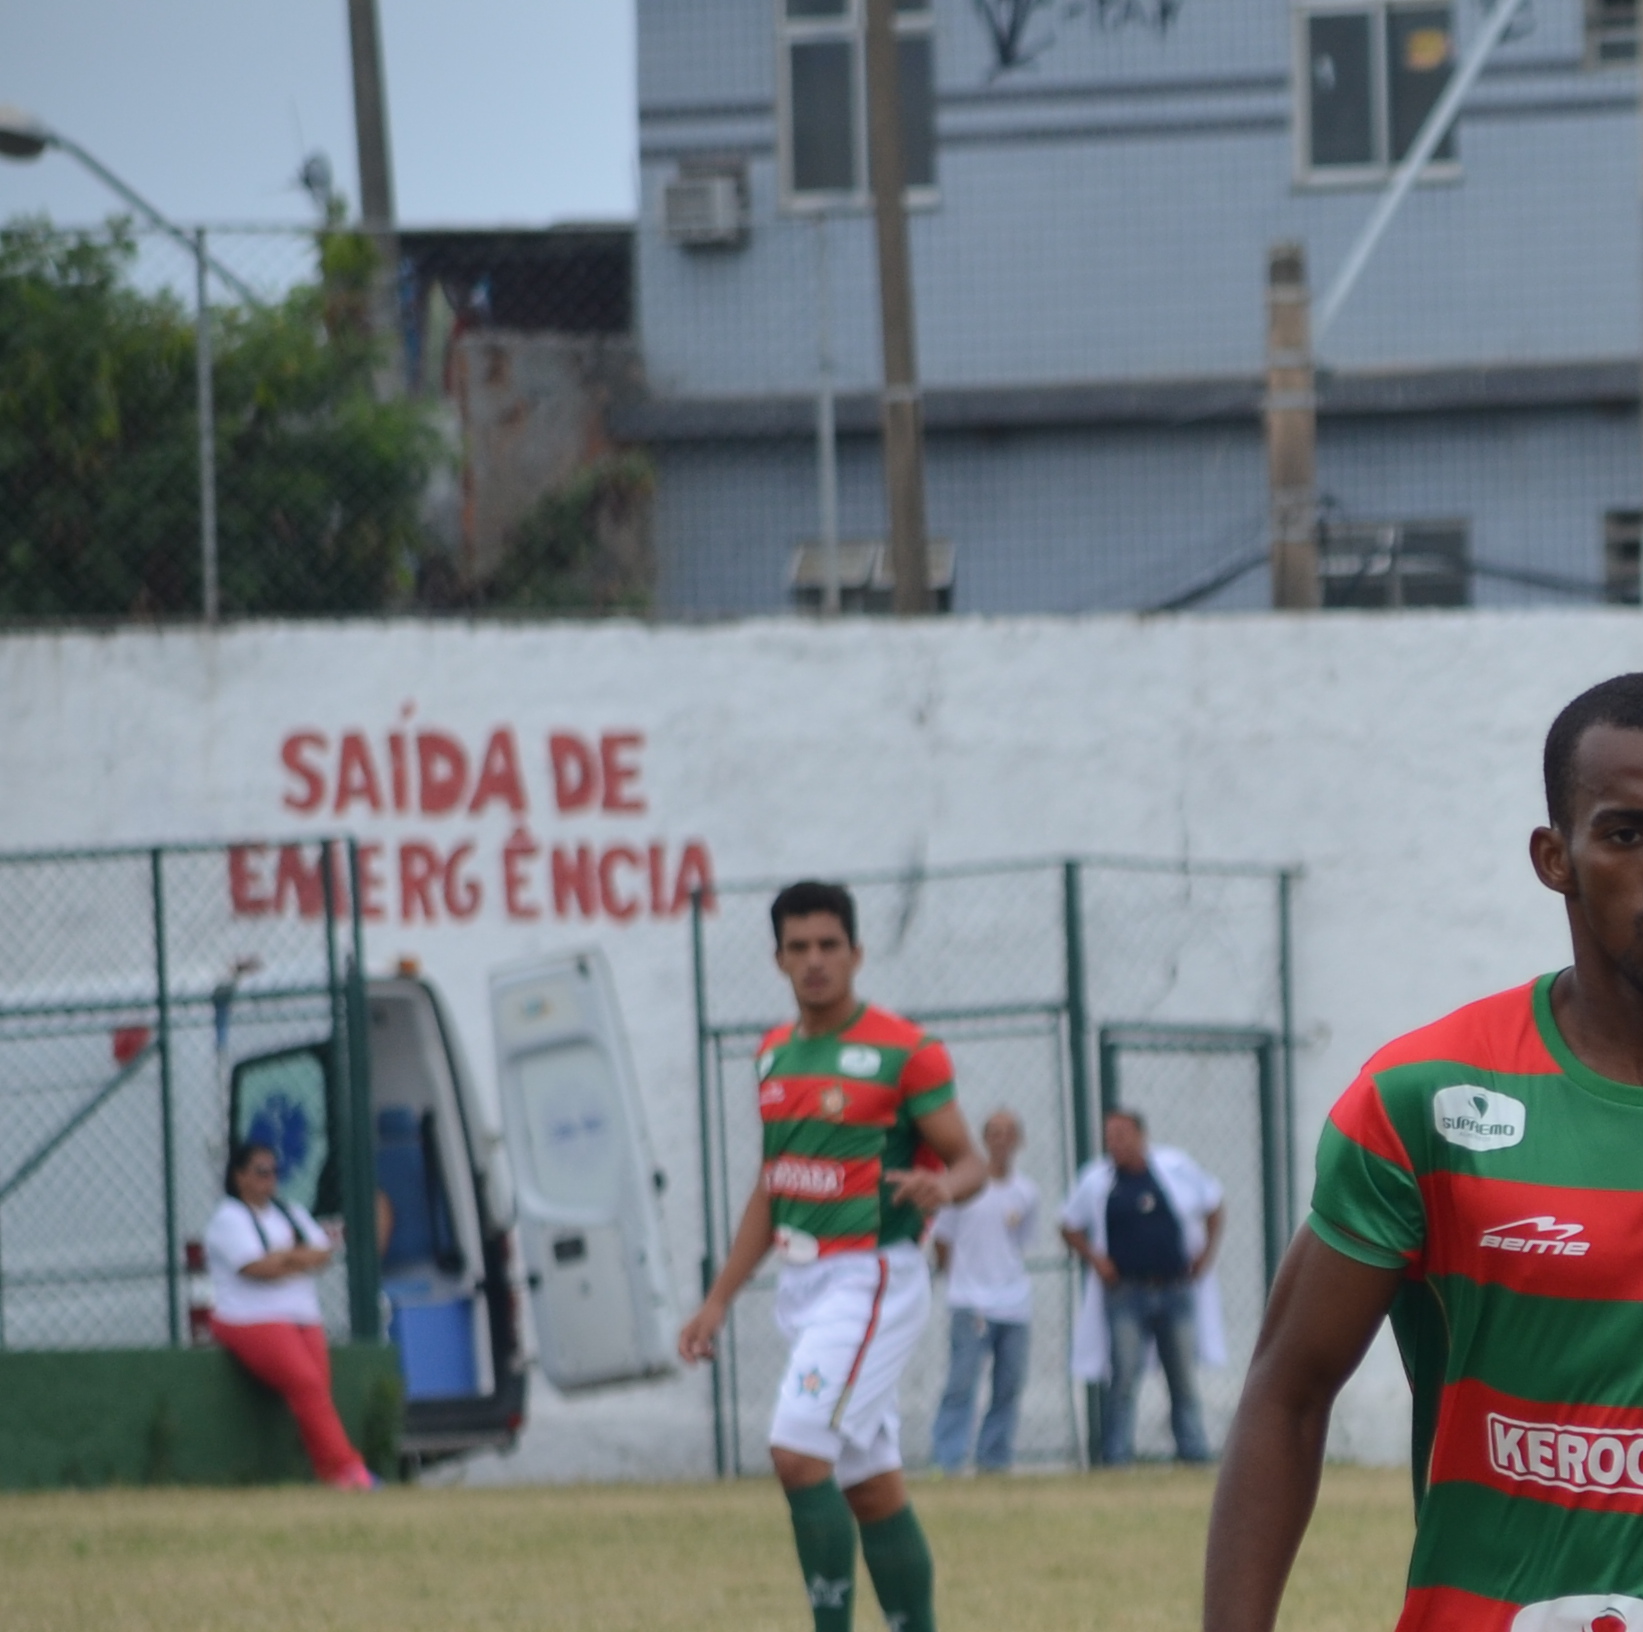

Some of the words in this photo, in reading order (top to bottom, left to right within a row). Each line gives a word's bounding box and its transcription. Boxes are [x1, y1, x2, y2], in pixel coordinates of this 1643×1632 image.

[280, 697, 530, 816] SAÍDA
[545, 729, 650, 815] DE
[225, 822, 718, 922] EMERGÊNCIA
[1442, 1115, 1516, 1137] SUPREMO
